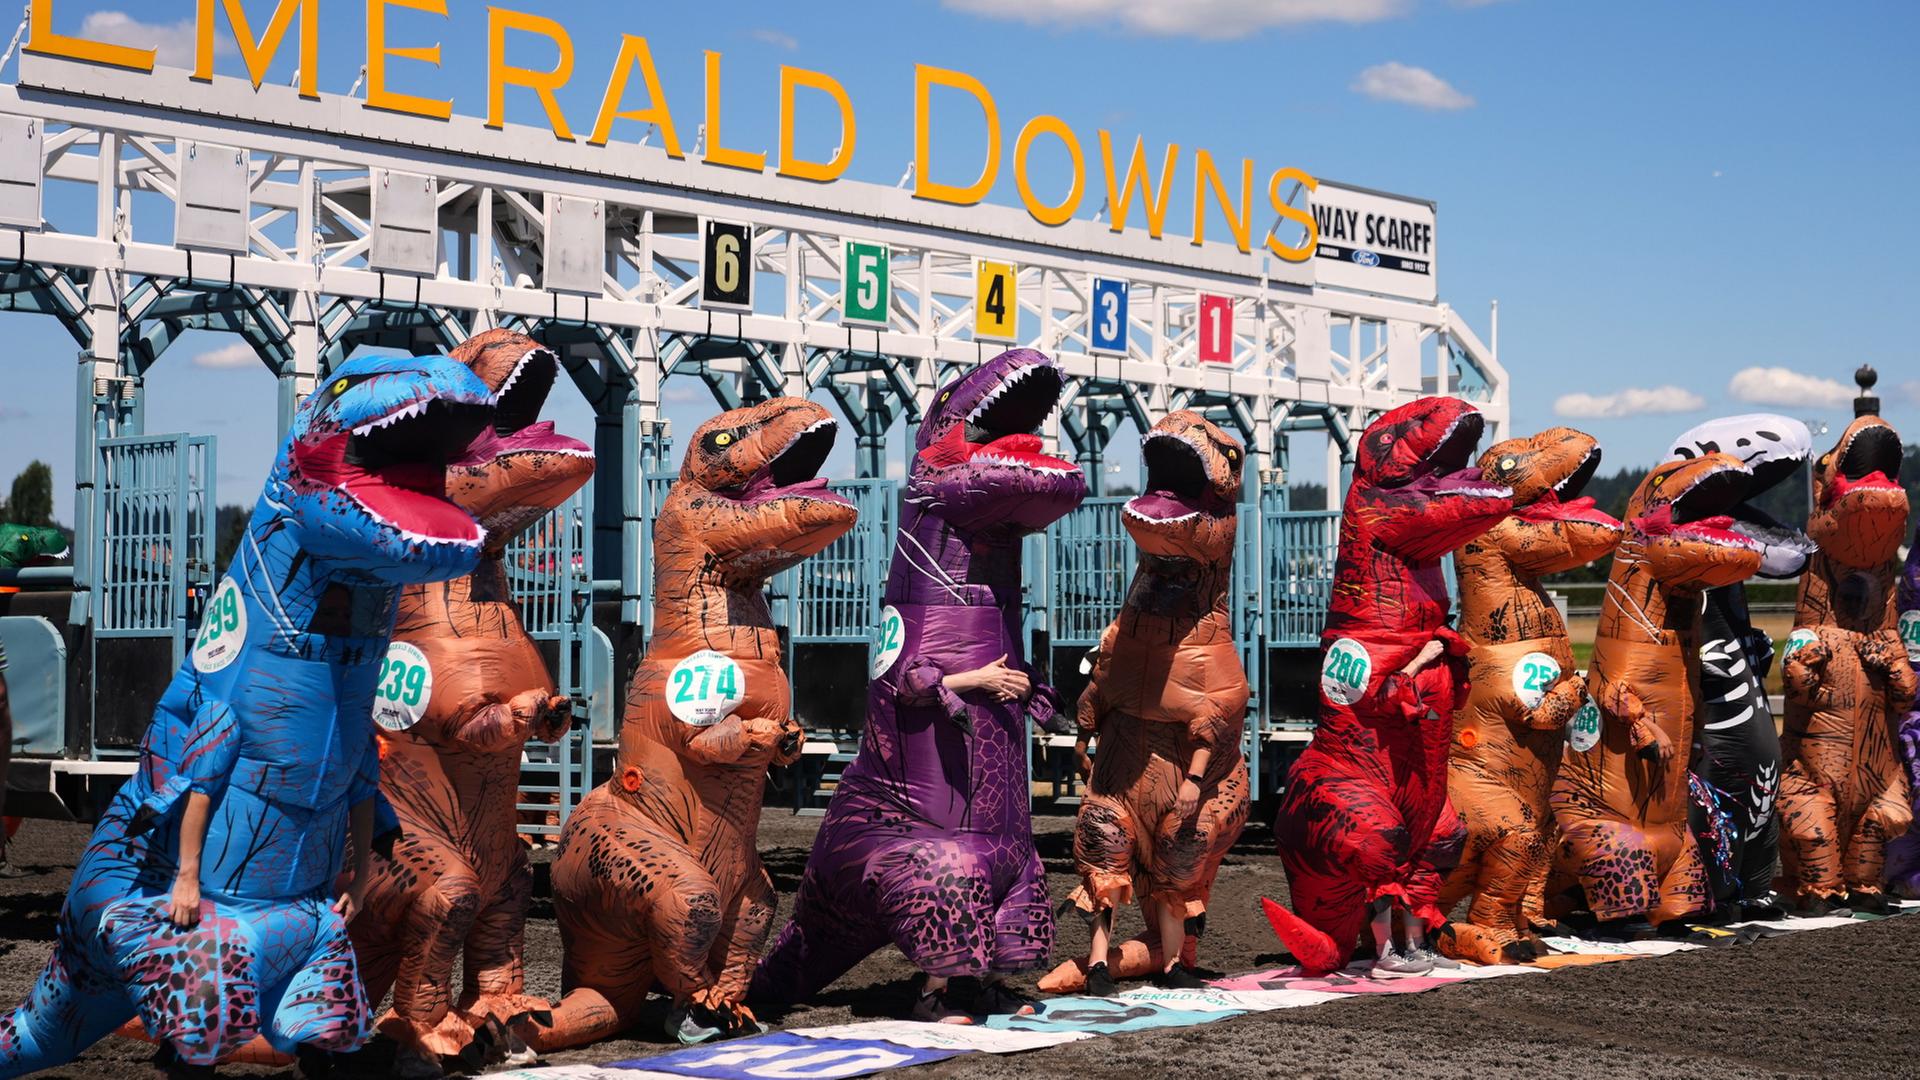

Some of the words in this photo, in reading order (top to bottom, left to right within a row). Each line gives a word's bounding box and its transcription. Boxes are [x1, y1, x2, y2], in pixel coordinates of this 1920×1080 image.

[912, 63, 1319, 262] DOWNS
[1311, 203, 1358, 242] WAY
[1365, 213, 1431, 254] SCARFF
[715, 233, 740, 293] 6
[857, 254, 879, 310] 5
[985, 274, 1005, 325] 4
[1100, 291, 1119, 342] 3
[1210, 307, 1222, 353] 1
[375, 656, 426, 706] 239
[674, 663, 737, 704] 274
[1325, 647, 1368, 689] 280
[1523, 662, 1559, 692] 25
[673, 1044, 915, 1078] 10
